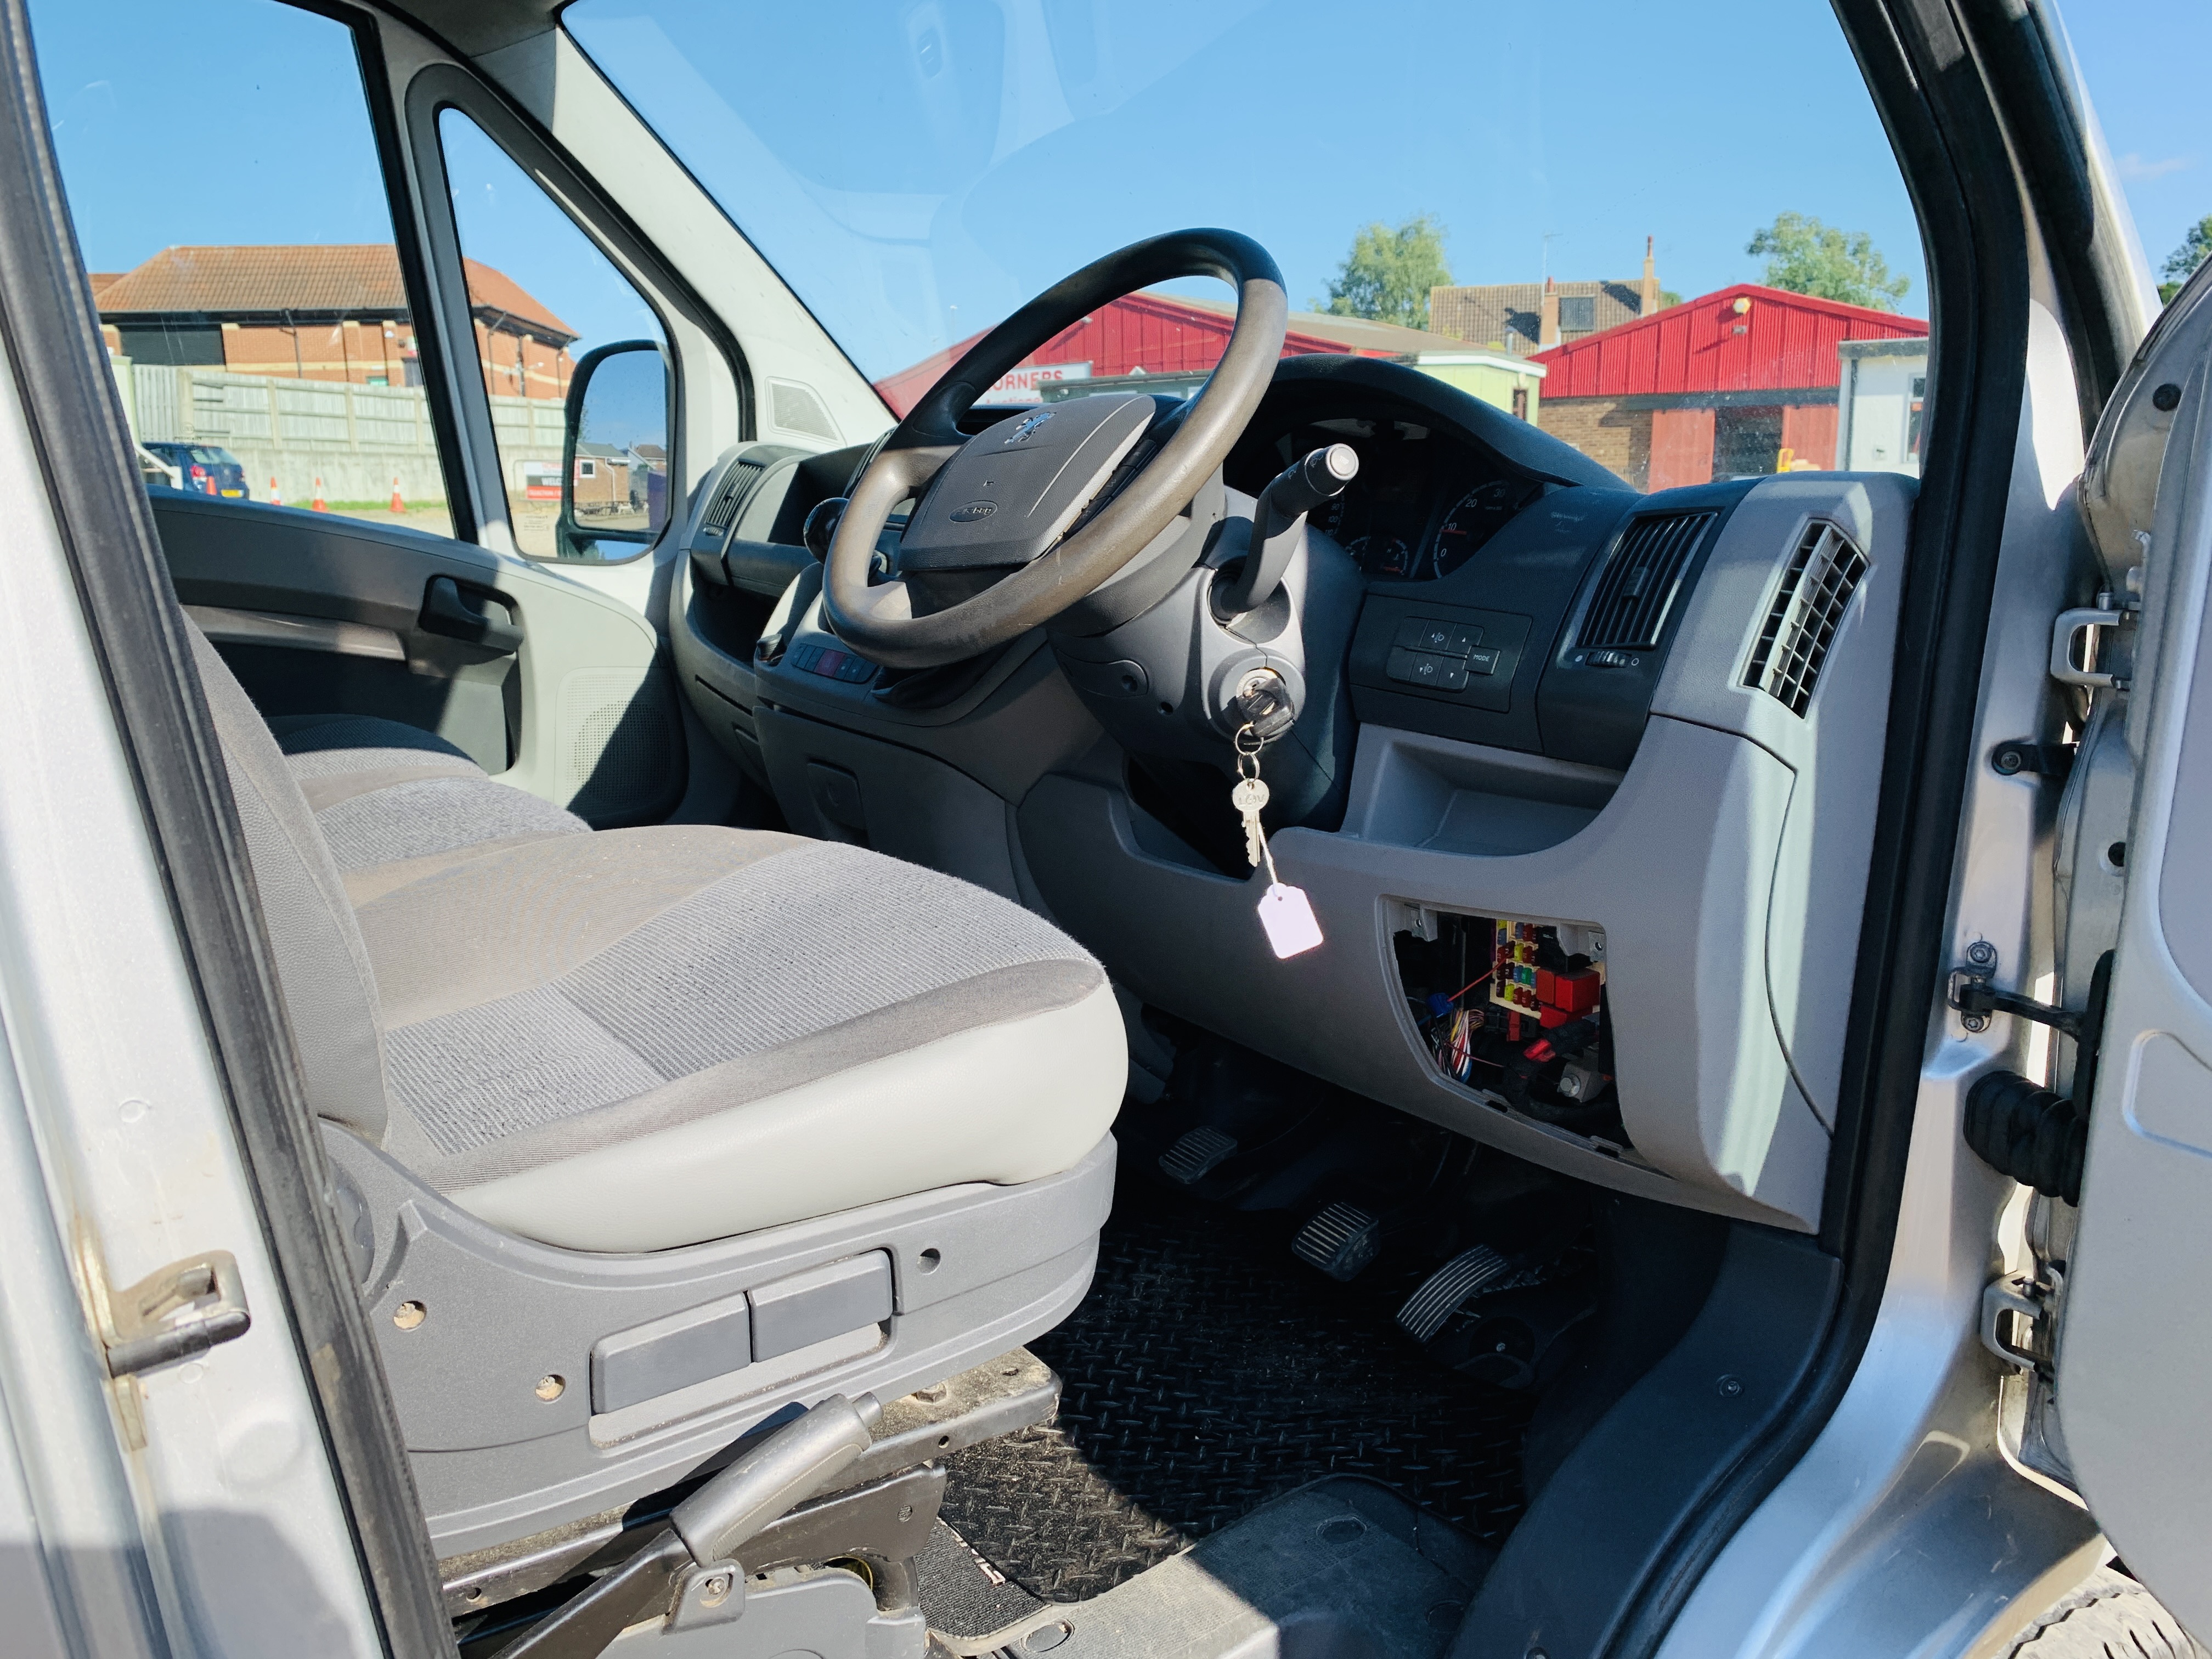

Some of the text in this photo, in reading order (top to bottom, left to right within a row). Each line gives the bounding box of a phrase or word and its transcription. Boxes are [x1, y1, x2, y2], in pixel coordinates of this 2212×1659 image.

[989, 370, 1063, 391] ORNERS
[1465, 499, 1477, 507] 20
[1448, 522, 1457, 531] 10
[1441, 548, 1447, 557] 0
[1473, 654, 1490, 662] MODE
